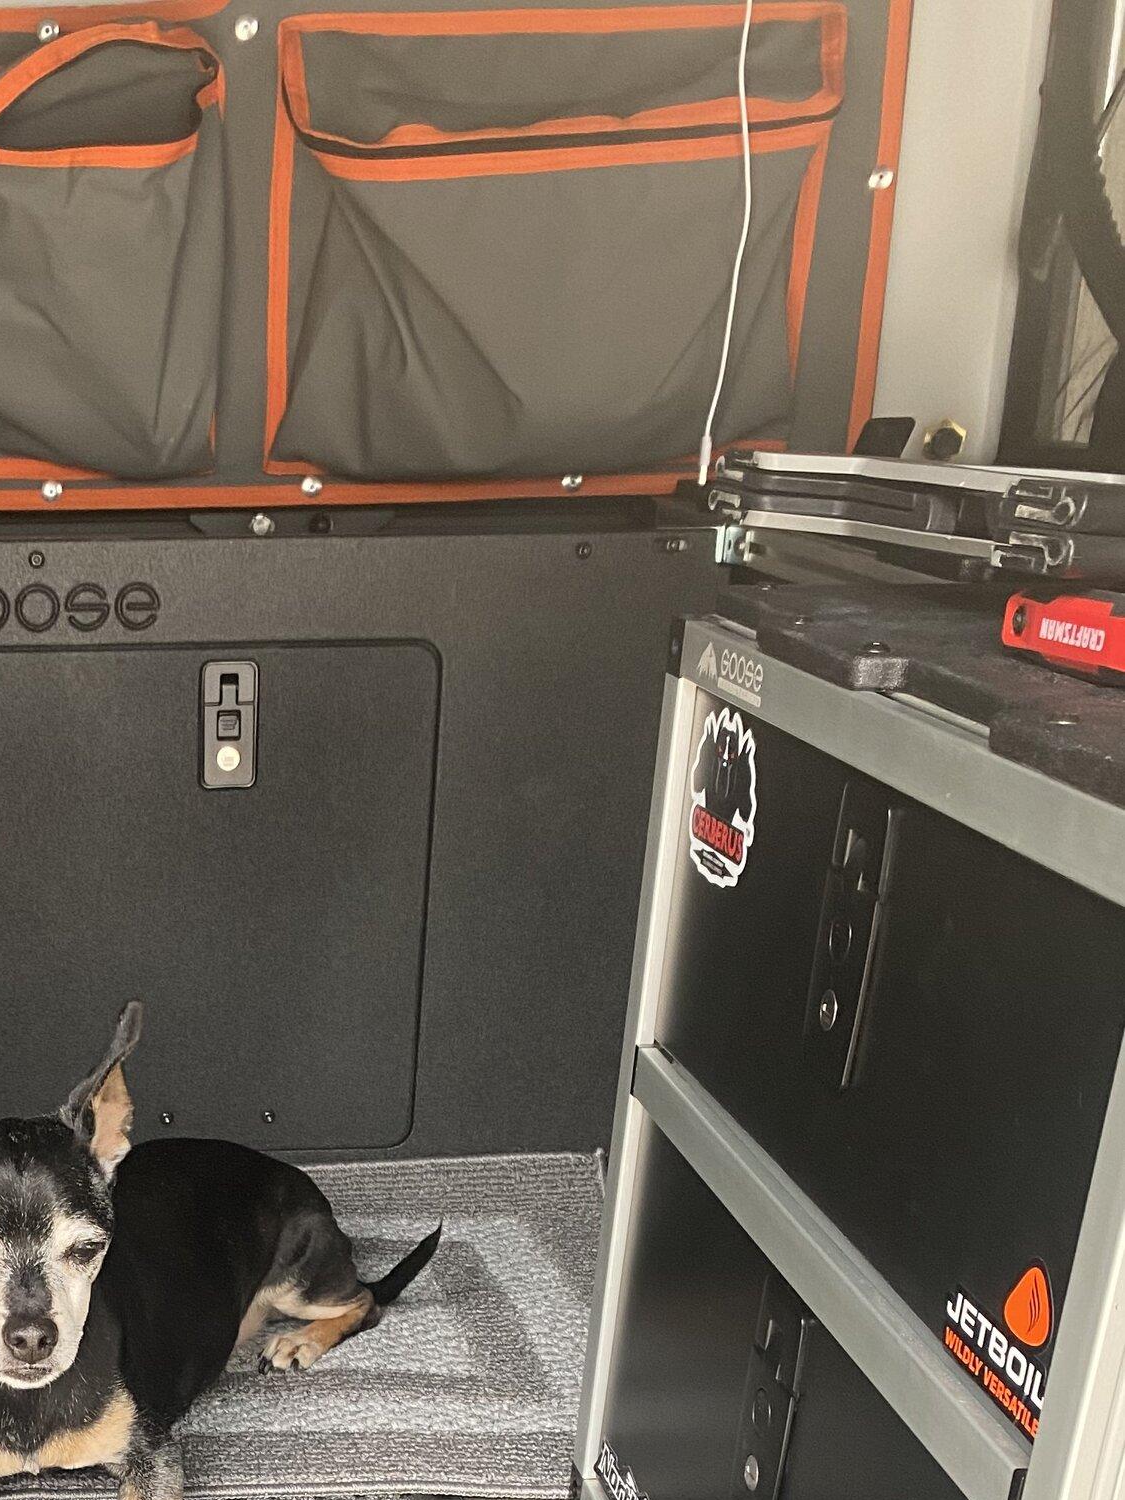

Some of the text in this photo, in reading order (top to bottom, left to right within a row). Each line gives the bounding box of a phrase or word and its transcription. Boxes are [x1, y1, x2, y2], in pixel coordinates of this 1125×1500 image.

[1039, 617, 1106, 652] CRAFTSMAN
[692, 806, 744, 865] CERBERUS
[945, 1326, 1040, 1439] WILDLY VERSATILE
[946, 1292, 1045, 1410] JETBOIL
